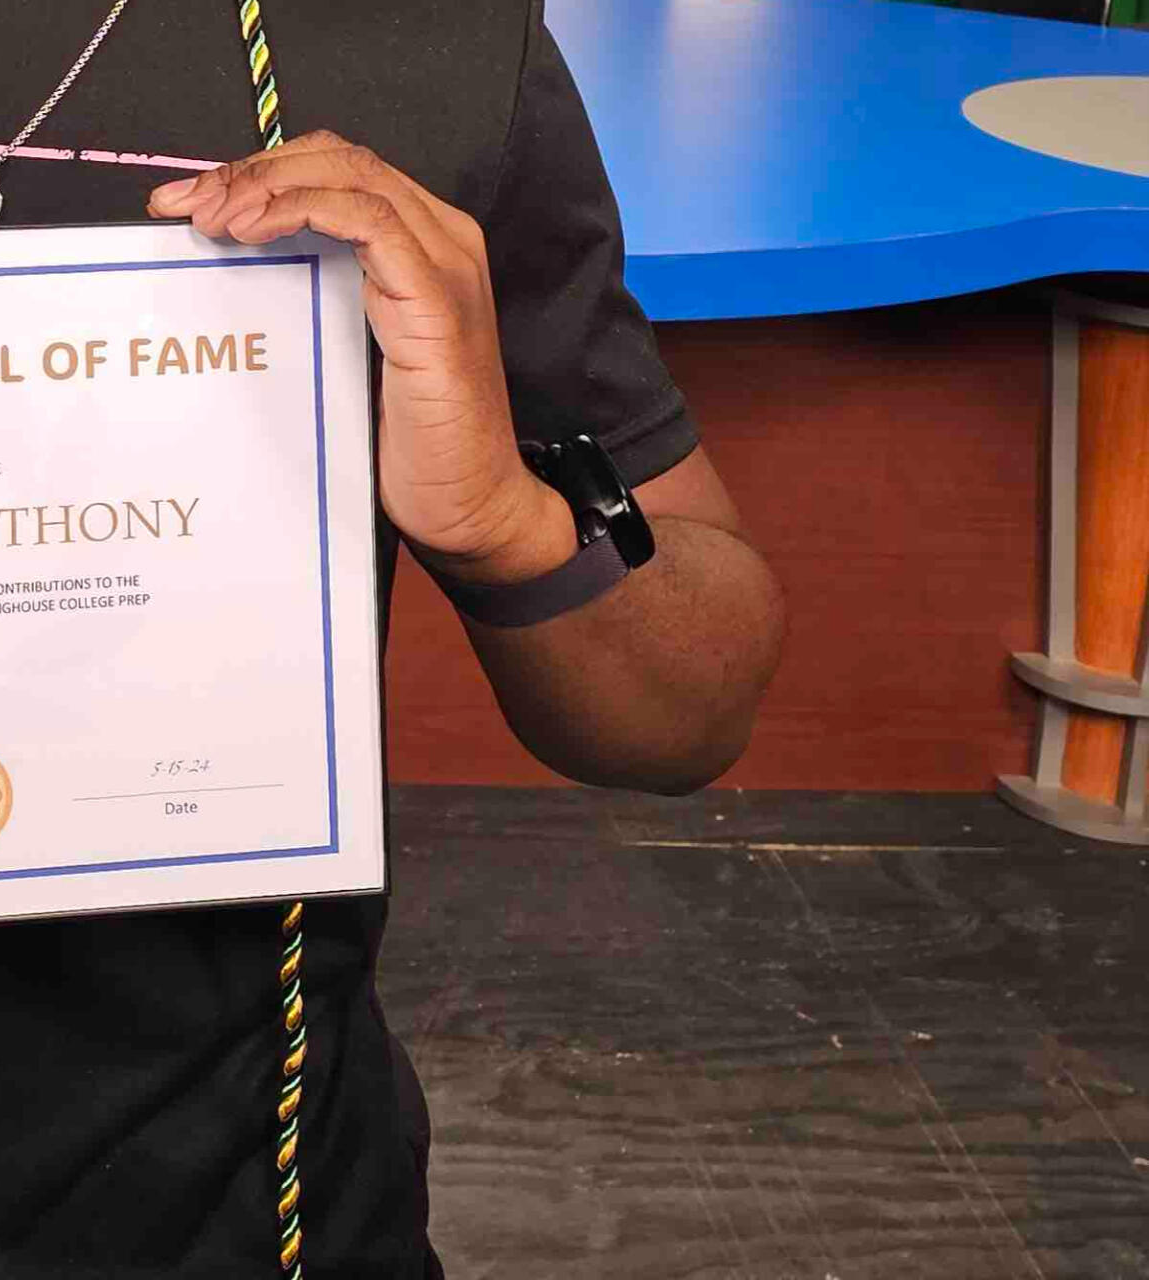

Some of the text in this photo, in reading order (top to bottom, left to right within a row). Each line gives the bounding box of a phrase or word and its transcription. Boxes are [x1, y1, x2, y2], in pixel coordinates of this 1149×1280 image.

[42, 340, 107, 380] OF
[129, 333, 268, 376] FAME
[95, 576, 112, 589] TO
[116, 575, 140, 587] THE
[59, 595, 114, 611] COLLEGE
[118, 593, 151, 606] PREP
[165, 801, 198, 815] Date
